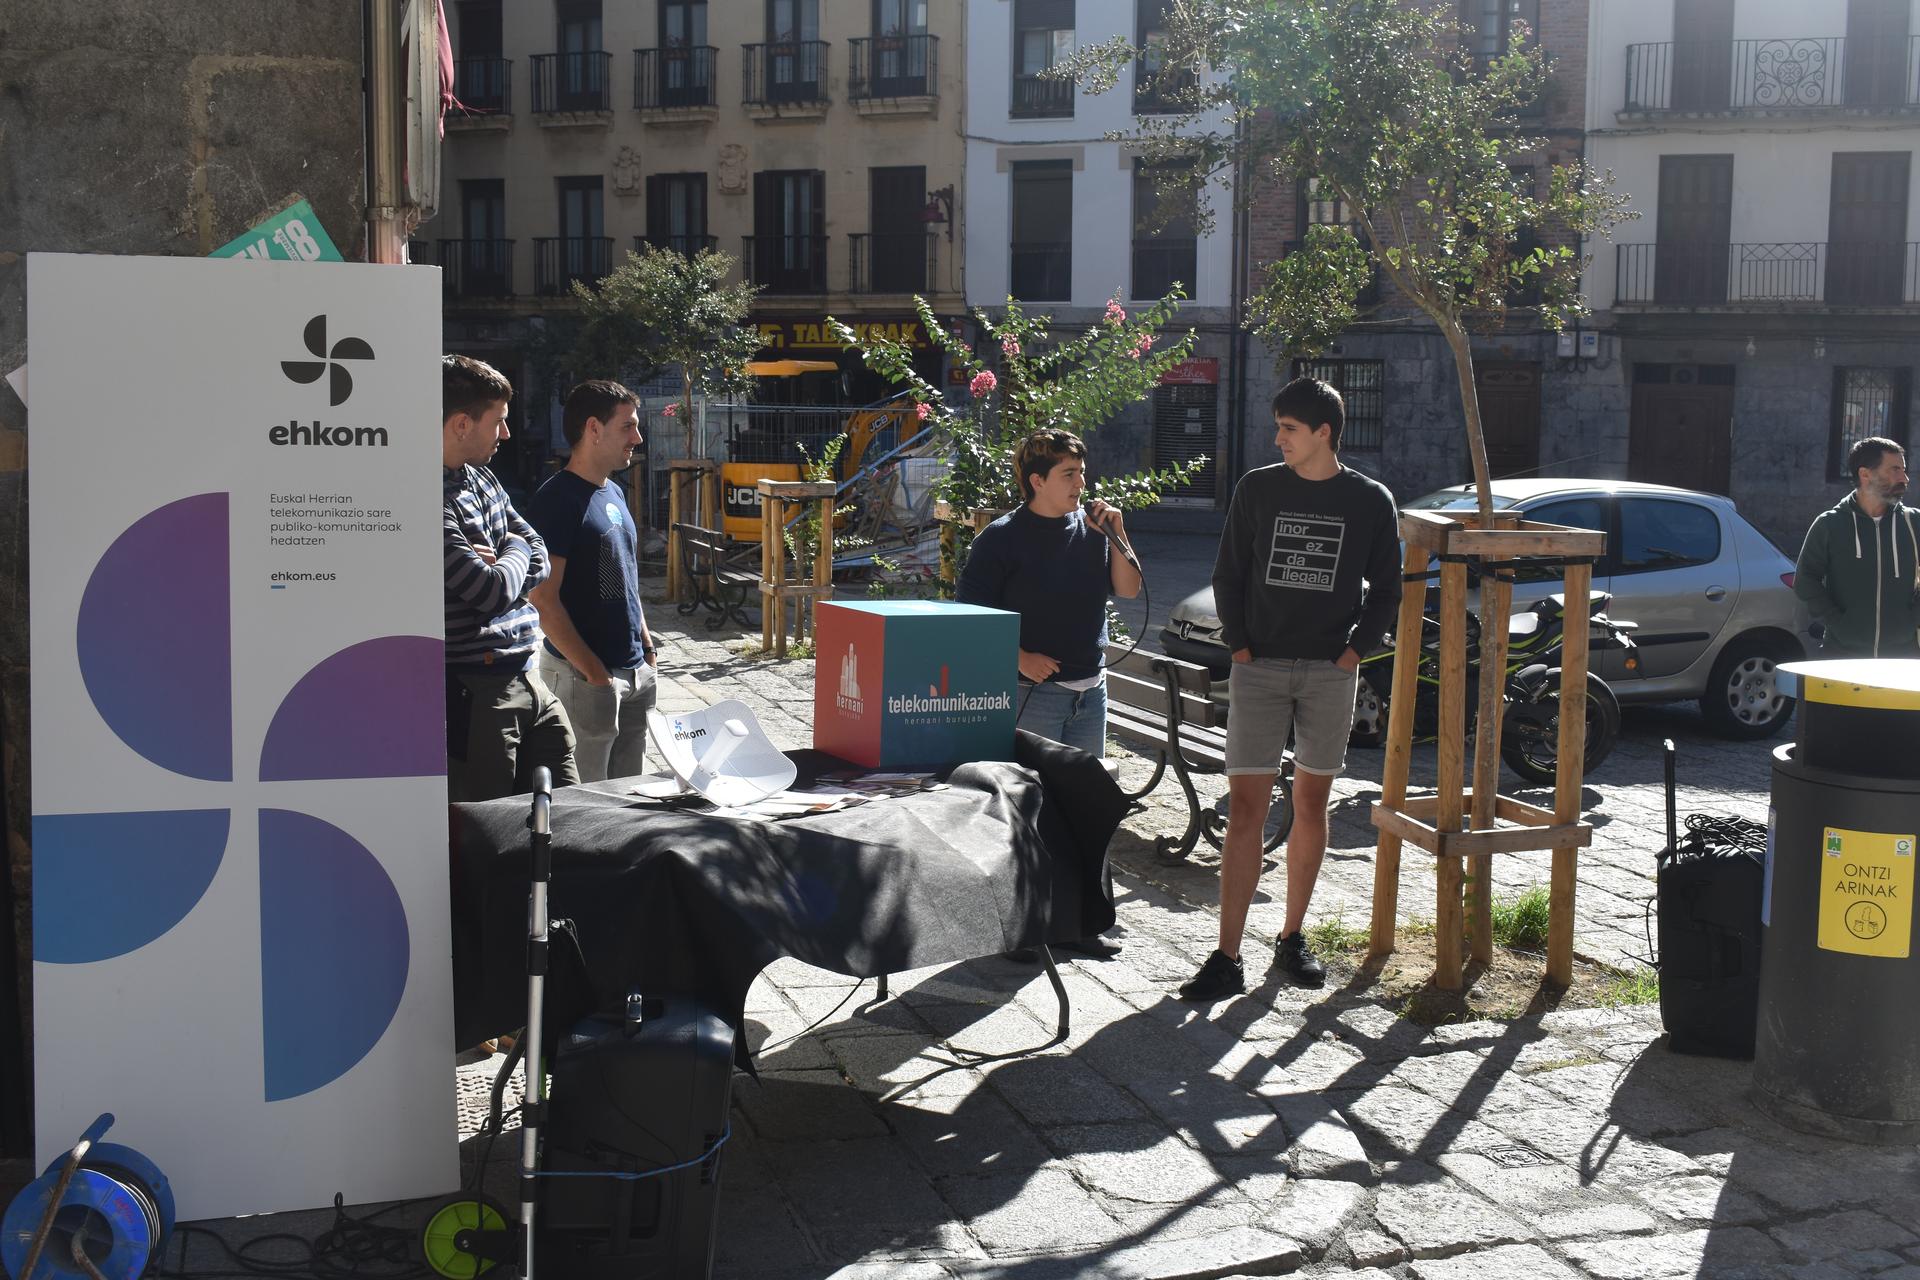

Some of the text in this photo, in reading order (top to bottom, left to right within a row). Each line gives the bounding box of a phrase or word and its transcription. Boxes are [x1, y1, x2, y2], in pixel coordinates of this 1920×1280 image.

[793, 323, 919, 343] TABKOAK
[870, 415, 889, 432] JCB
[268, 420, 389, 447] ehkom
[270, 493, 353, 504] Euskal Herrian
[270, 507, 391, 518] telekomunikazio sare
[270, 521, 402, 534] publiko-komunitarioak
[1279, 520, 1310, 535] inor
[270, 535, 326, 546] hedatzen
[1305, 541, 1324, 553] ez
[1286, 553, 1306, 566] da
[270, 571, 337, 582] ehkom.eus
[1281, 567, 1330, 585] ilegala
[836, 691, 864, 714] hernani
[888, 692, 1011, 714] telekomunikazioak
[904, 715, 987, 725] hernani burujabe
[674, 728, 707, 741] ehkom
[1843, 863, 1891, 880] ONTZI
[1834, 880, 1897, 898] ARINAK
